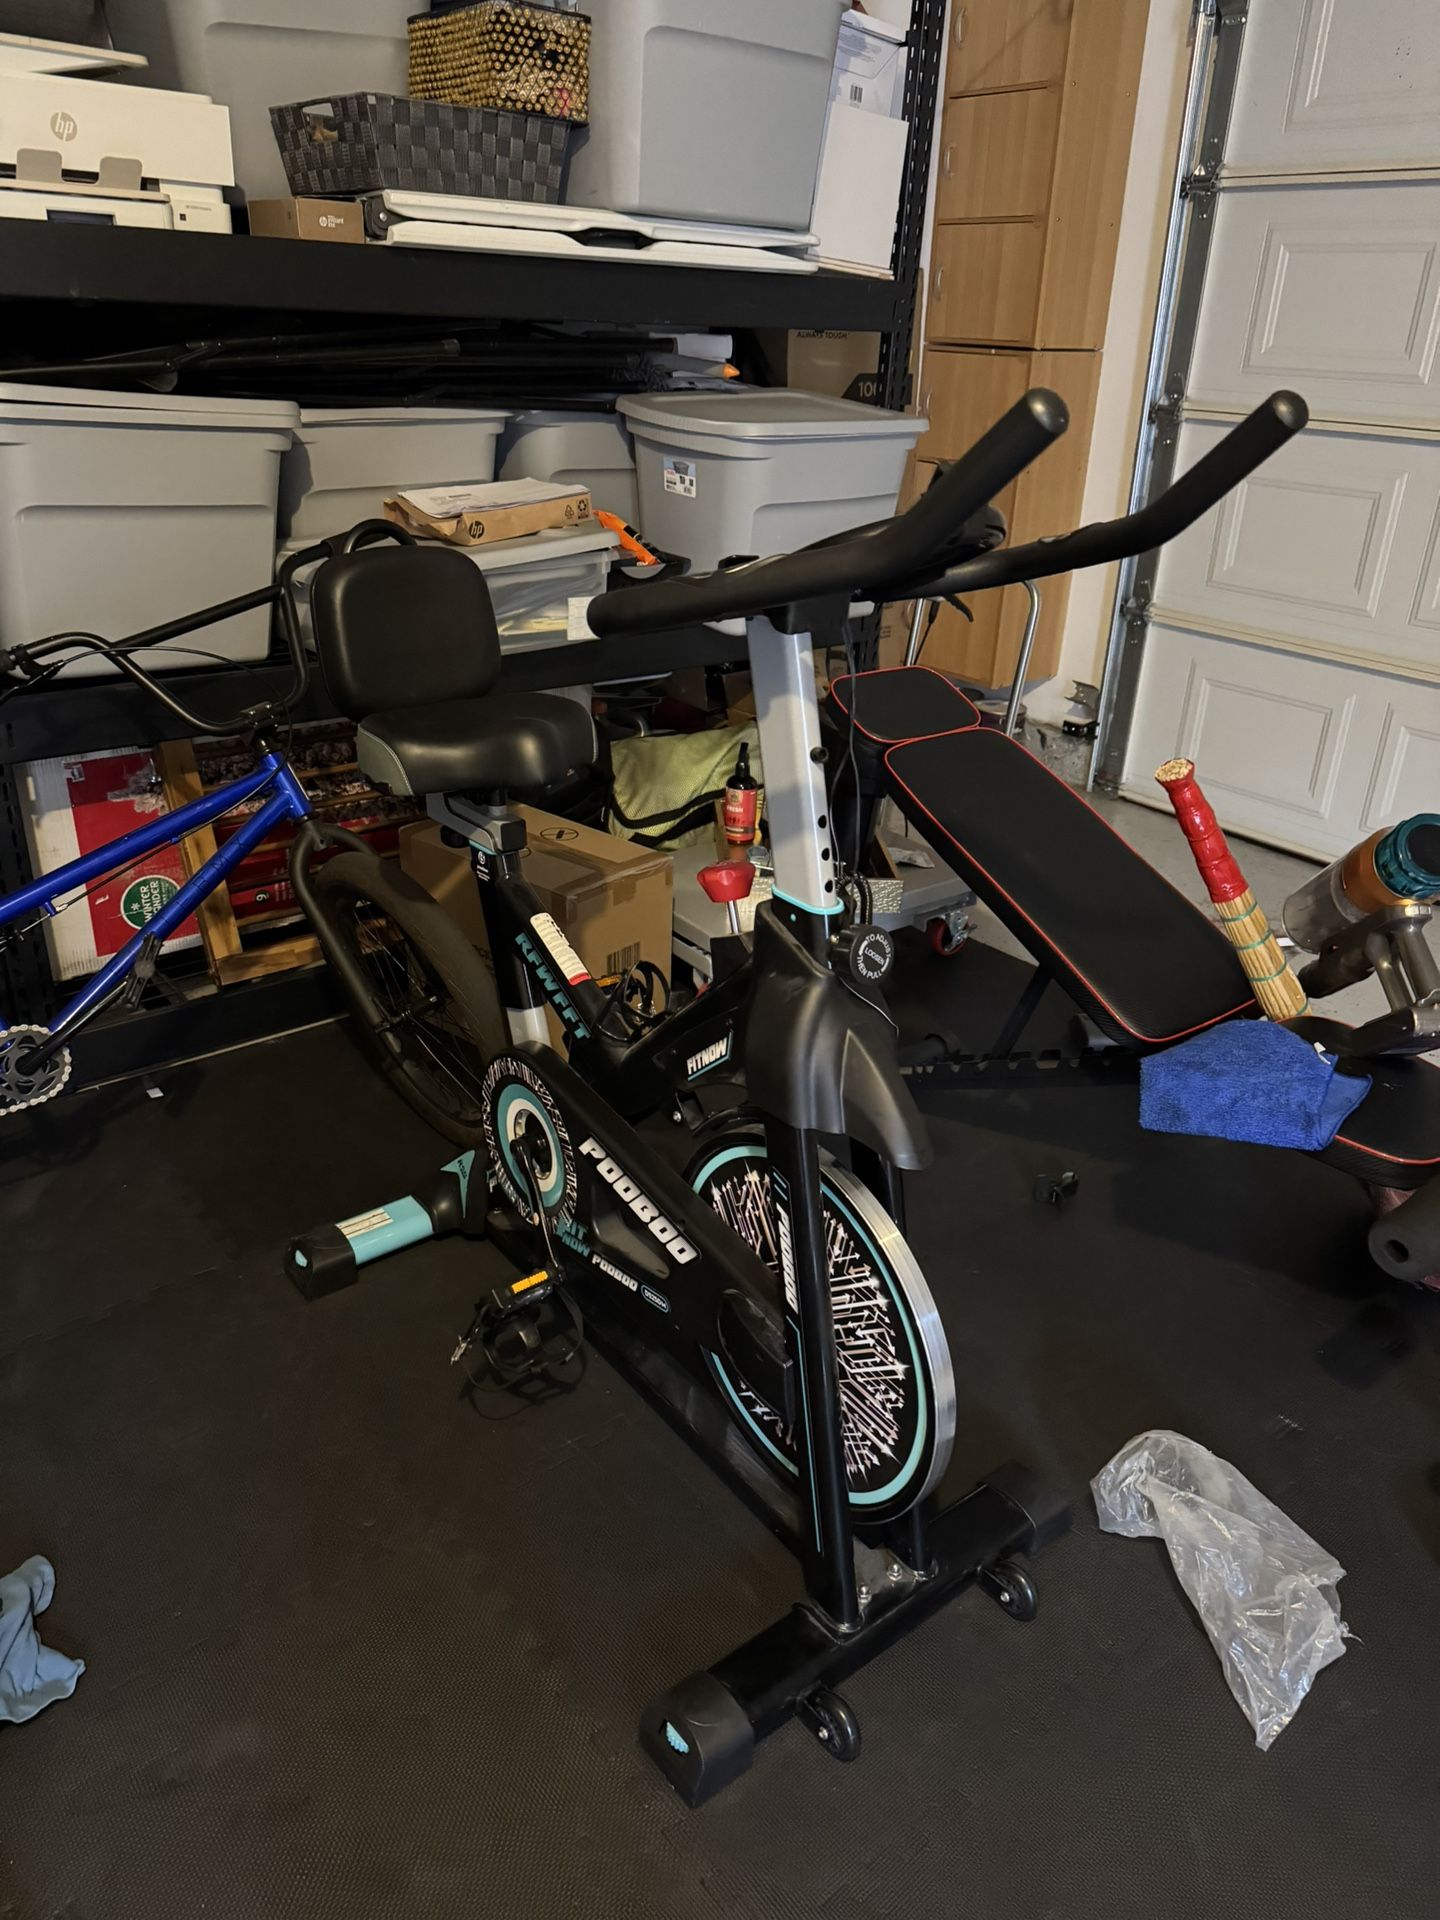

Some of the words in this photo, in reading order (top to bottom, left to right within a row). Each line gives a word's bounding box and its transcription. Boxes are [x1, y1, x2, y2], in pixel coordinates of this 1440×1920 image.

[52, 112, 76, 141] hp
[469, 521, 484, 539] hp
[140, 885, 152, 922] WINTER
[150, 880, 161, 914] ONDER
[864, 947, 884, 965] LOOSEN
[865, 934, 876, 943] TO
[876, 934, 891, 957] ADJUST
[857, 955, 868, 976] THEN
[866, 970, 882, 979] PULL
[687, 1037, 727, 1075] FITNOW
[578, 1137, 698, 1265] POOBOO
[561, 1233, 591, 1257] NOW
[592, 1254, 638, 1292] POOBOO
